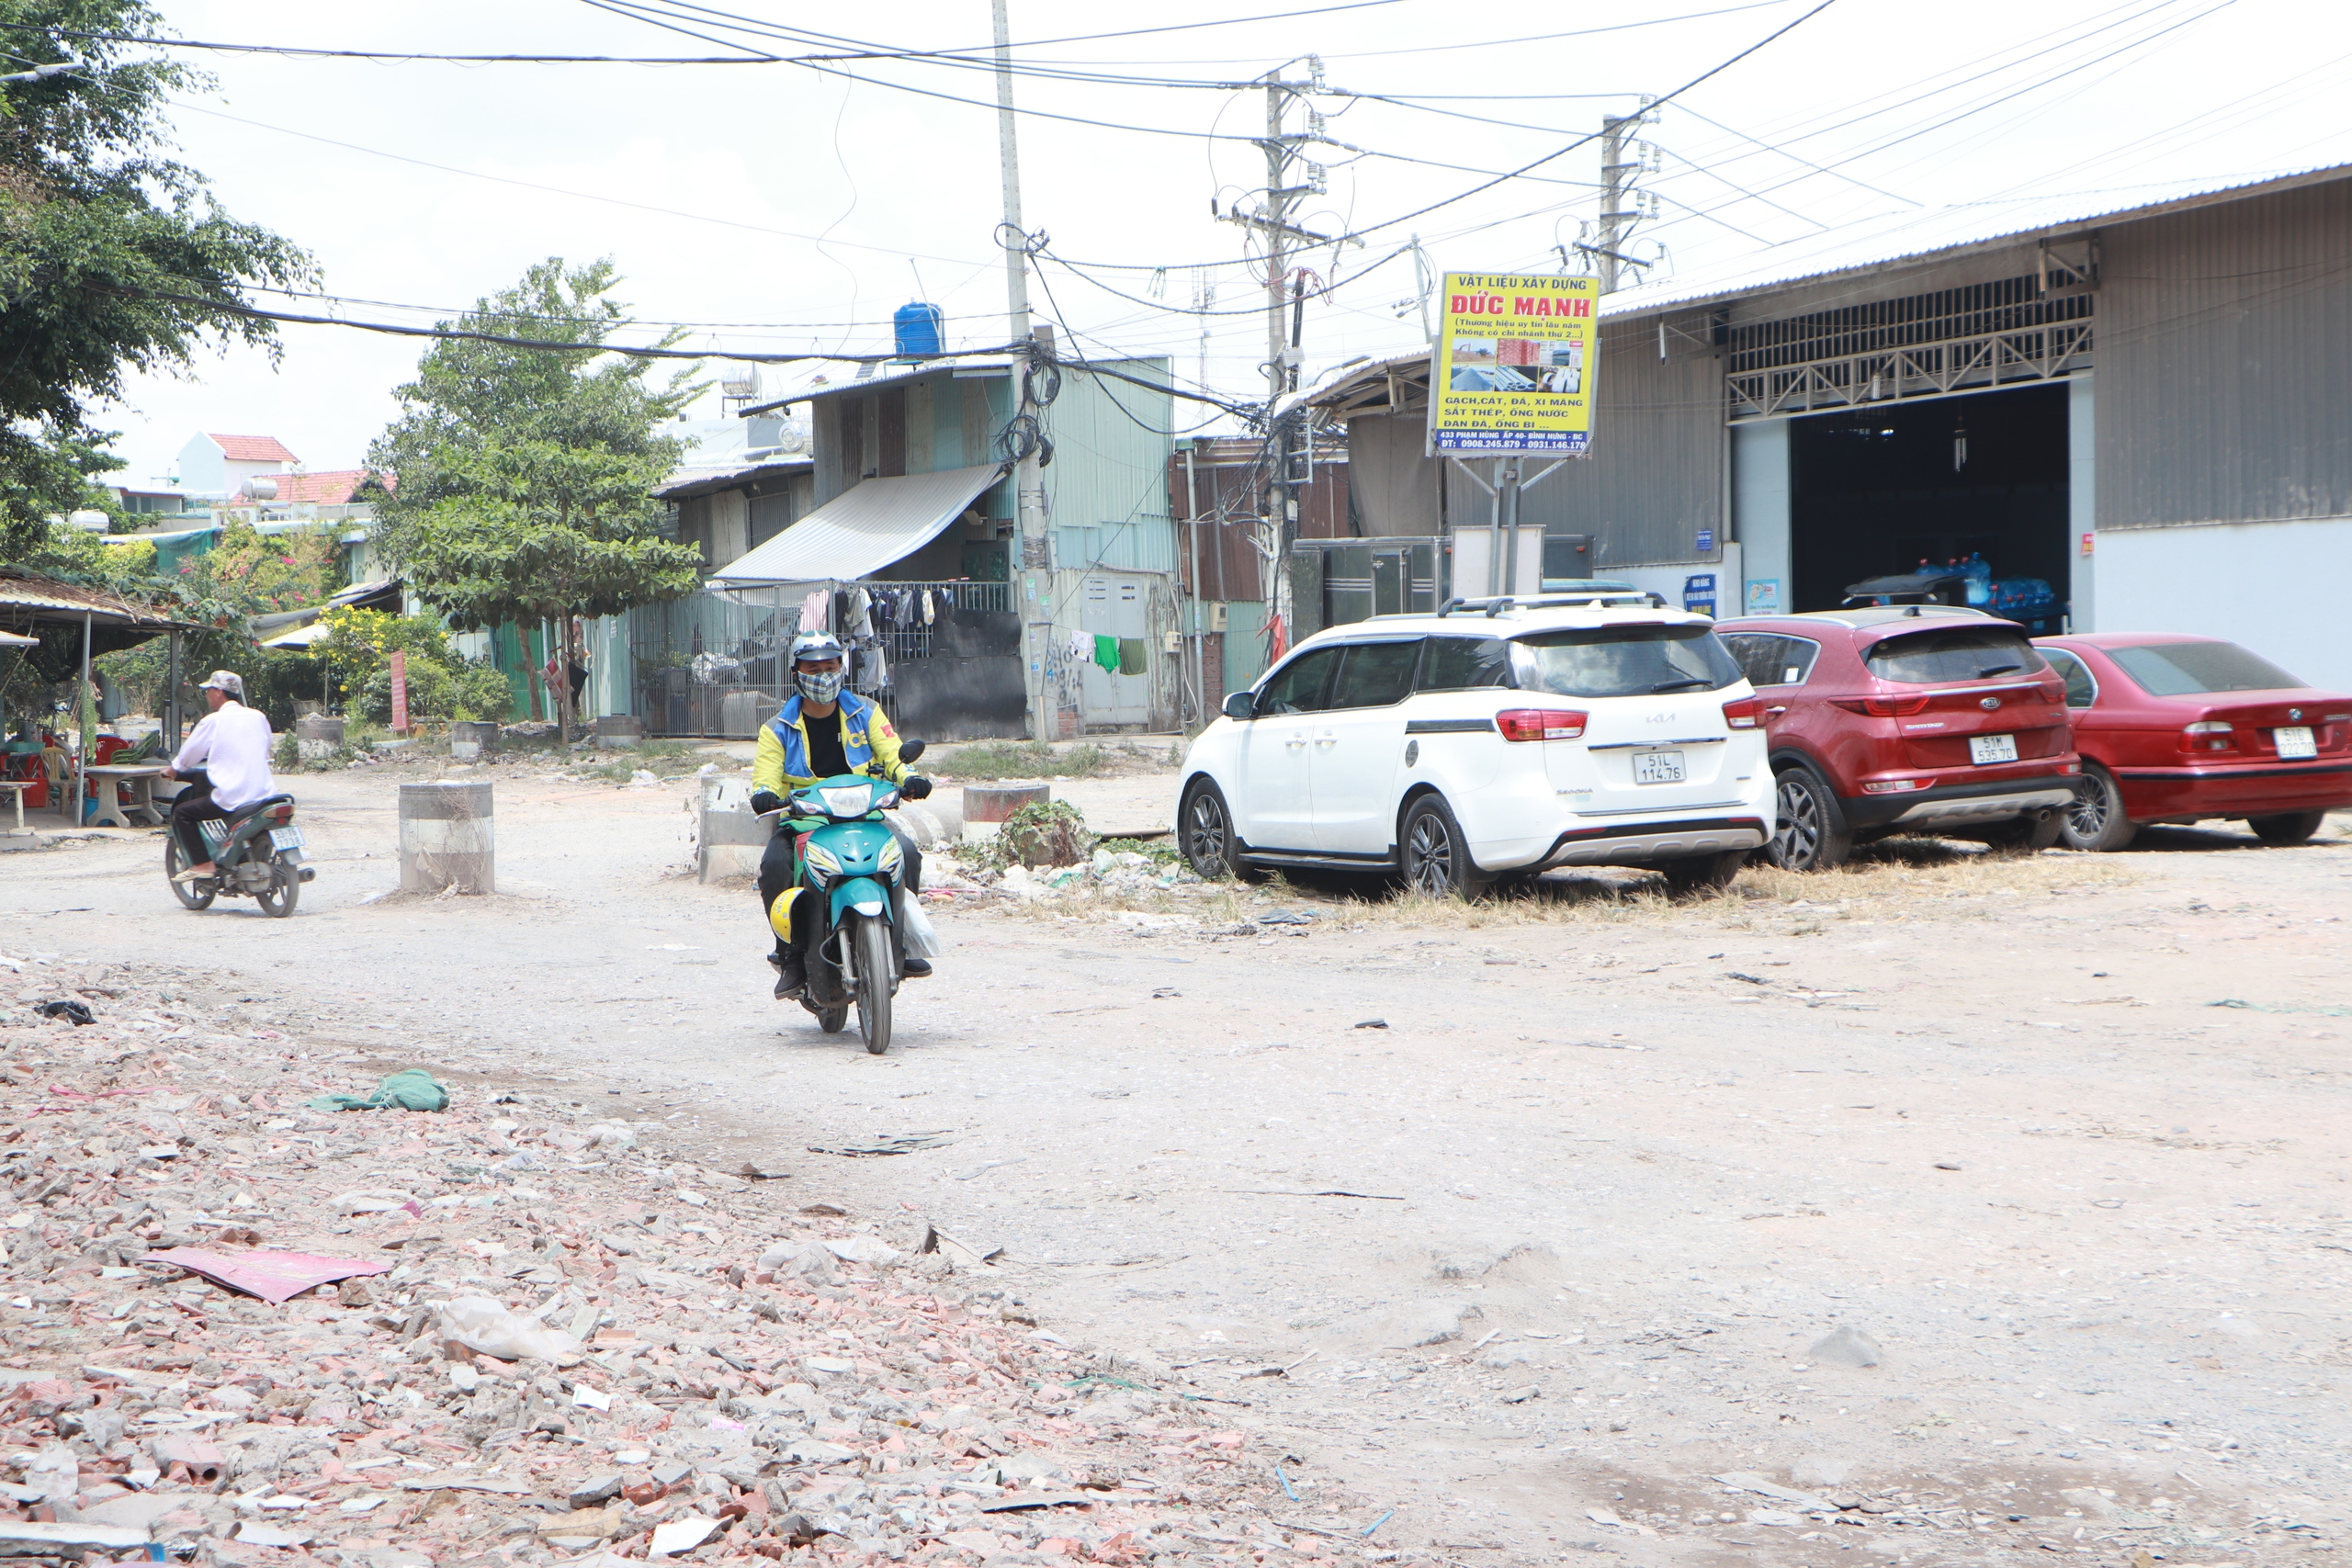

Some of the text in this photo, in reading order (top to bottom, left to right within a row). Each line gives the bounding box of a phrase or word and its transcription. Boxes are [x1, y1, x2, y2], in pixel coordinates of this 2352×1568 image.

[1459, 274, 1587, 291] VẬT LIỆU XÂY DỰNG
[1451, 289, 1591, 321] ĐỨC MẠNH
[1455, 317, 1493, 328] (Thương
[1496, 320, 1515, 328] hiệu
[1531, 320, 1543, 328] tín
[1546, 321, 1560, 329] lâu
[1562, 321, 1582, 330] năm
[1455, 328, 1485, 337] Không
[1487, 328, 1498, 336] có
[1518, 329, 1545, 337] nhánh
[1548, 330, 1563, 338] thứ
[1511, 395, 1531, 406] ĐÁ,
[1534, 398, 1545, 406] XI
[1549, 398, 1584, 407] MĂNG
[1444, 406, 1569, 418] SẮT THÉP, ỐNG NƯỚC
[1443, 420, 1468, 428] ĐAN
[1472, 418, 1491, 429] ĐÀ,
[1495, 418, 1520, 428] ỐNG
[1523, 421, 1535, 429] BI
[1478, 431, 1499, 439] HÙNG
[1503, 430, 1513, 439] ẤP
[1528, 432, 1546, 440] BÌNH
[1547, 433, 1567, 441] HƯNG
[1573, 433, 1583, 441] BC
[1442, 438, 1456, 448] ĐT:
[1461, 439, 1520, 448] 0908.245.879
[1527, 440, 1587, 449] 0931.146.178
[1985, 698, 1999, 707] KIA
[1984, 737, 2004, 749] 51M
[1648, 754, 1670, 767] 51L
[1978, 748, 2013, 761] 535.70
[1642, 767, 1681, 781] 114.76
